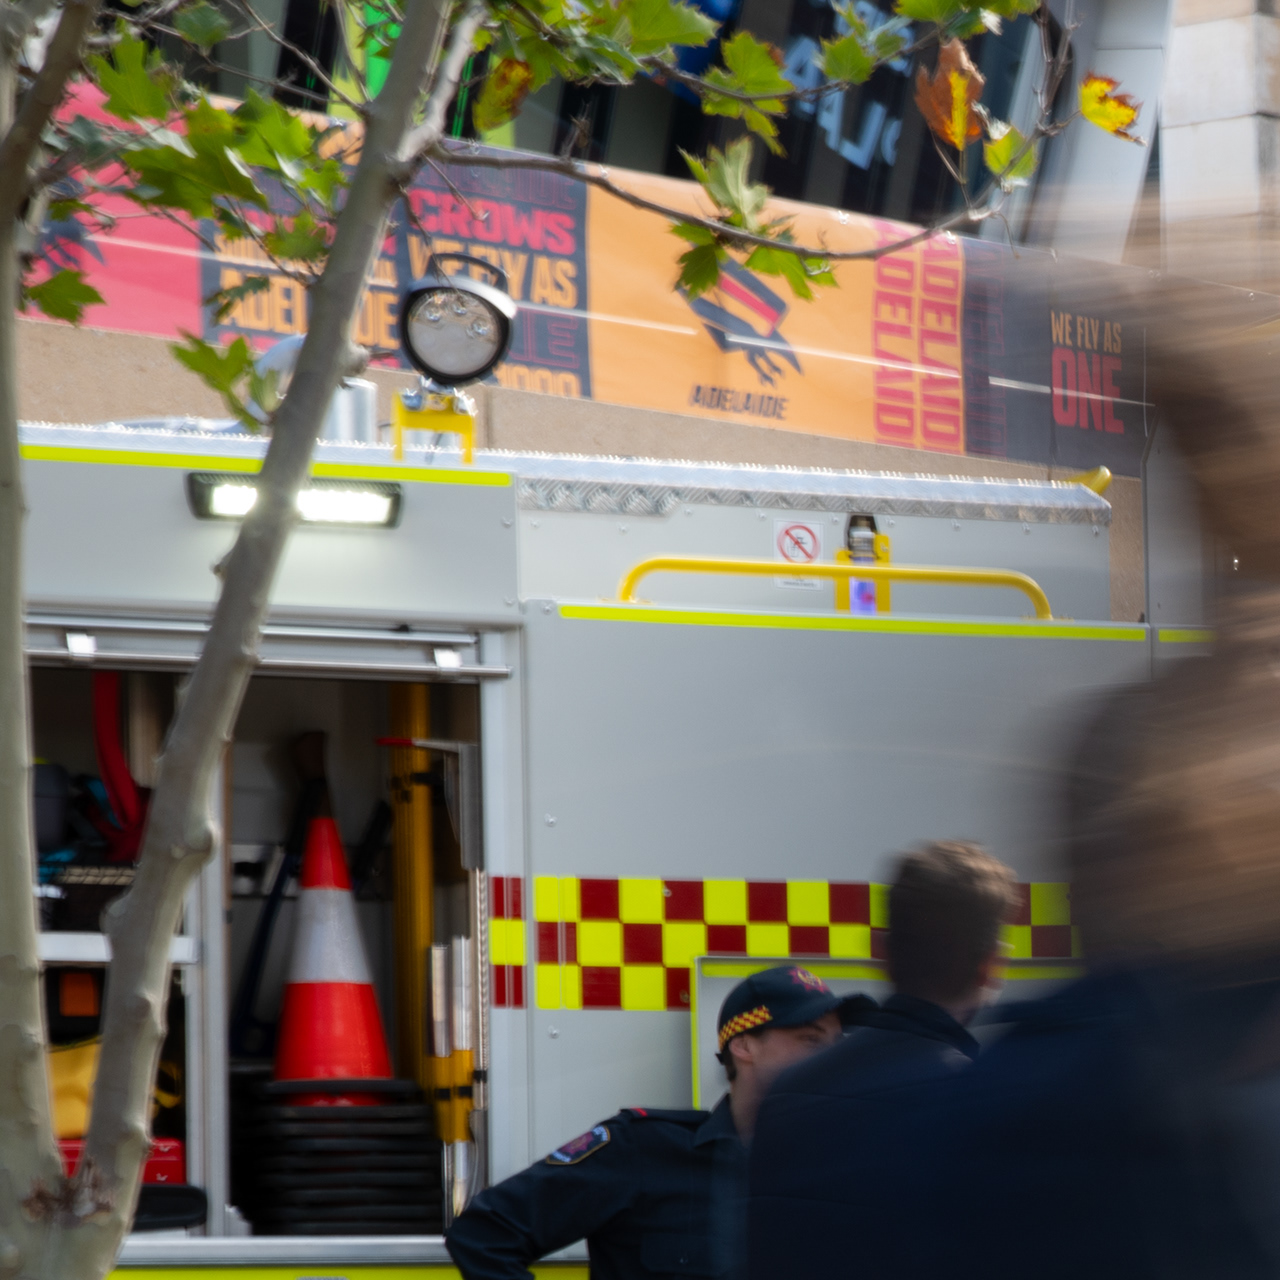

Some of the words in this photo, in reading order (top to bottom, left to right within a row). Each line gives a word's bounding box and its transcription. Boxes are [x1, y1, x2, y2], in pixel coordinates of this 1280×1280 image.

[409, 188, 577, 255] CROWS
[530, 254, 579, 310] AS
[872, 218, 917, 450] ADELAID
[919, 229, 962, 456] ADELAID
[1051, 309, 1074, 346] WE
[1076, 314, 1102, 351] FLY
[1103, 319, 1122, 354] AS
[688, 384, 789, 420] ADELAIDE
[1051, 348, 1125, 434] ONE
